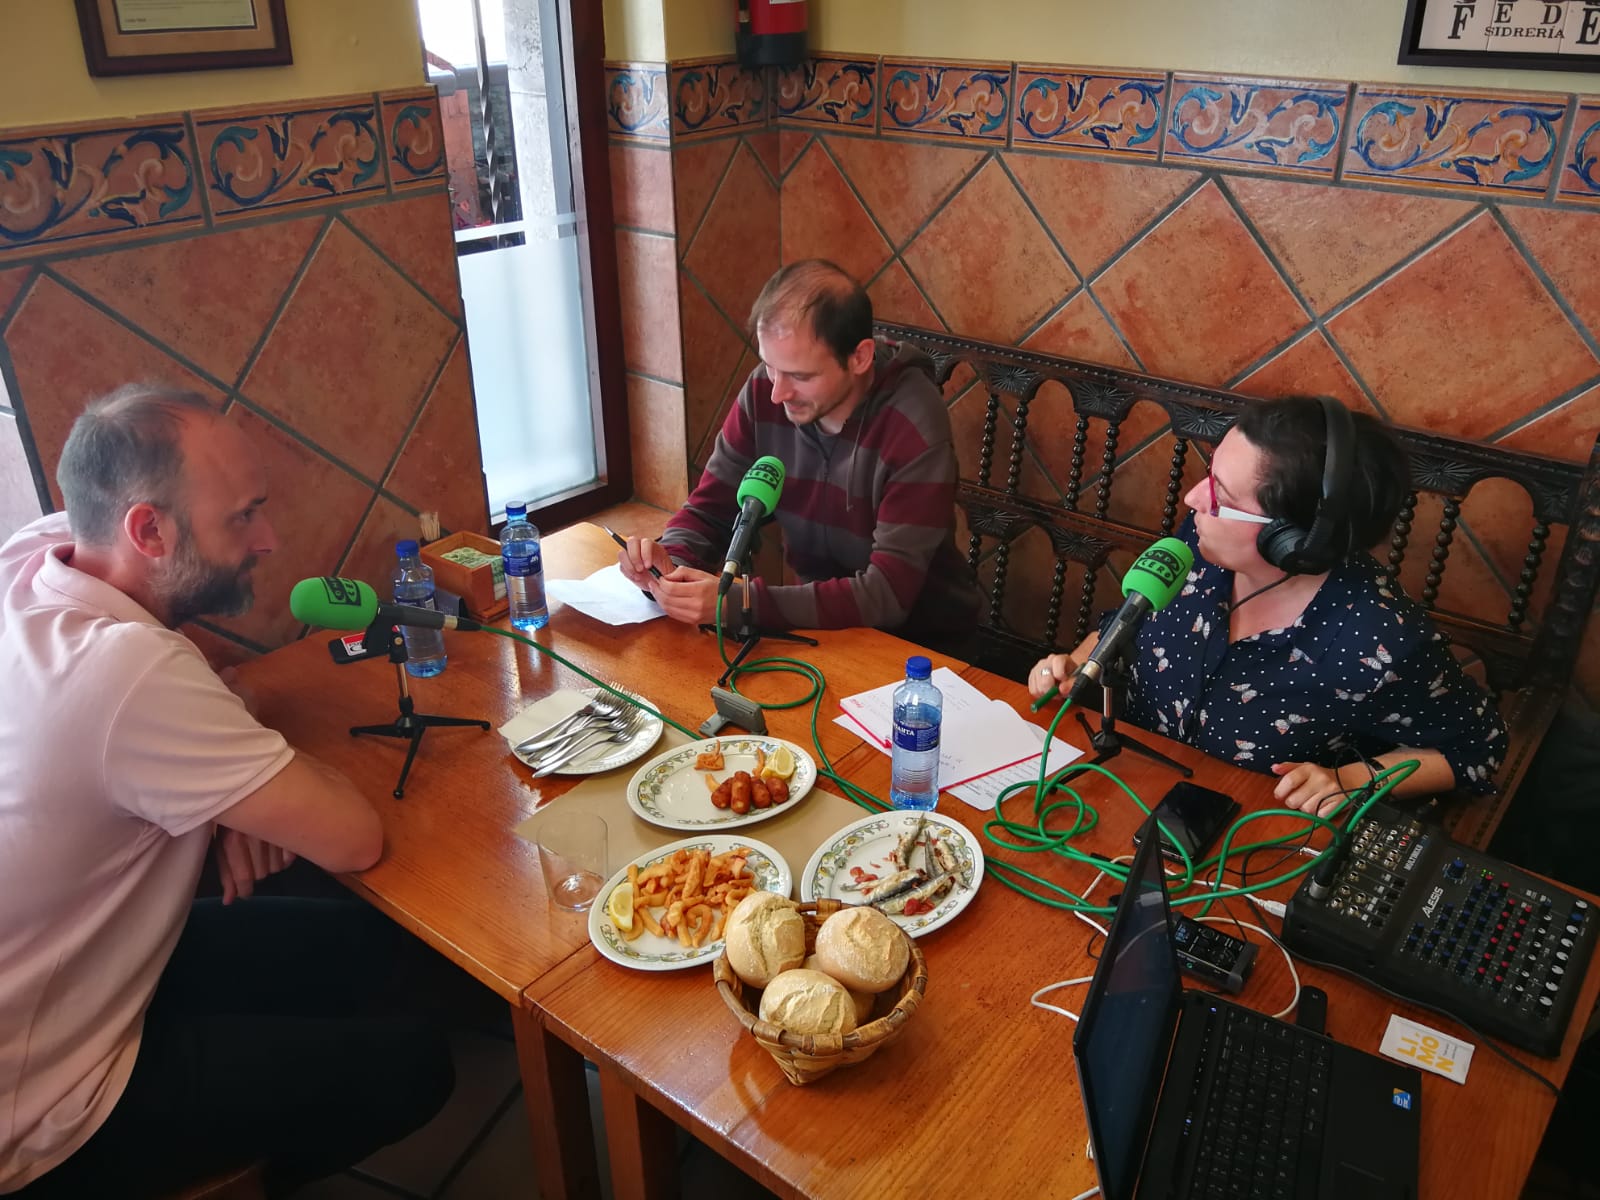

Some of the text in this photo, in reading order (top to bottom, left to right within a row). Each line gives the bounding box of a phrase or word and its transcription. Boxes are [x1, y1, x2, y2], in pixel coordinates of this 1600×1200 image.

[1484, 25, 1565, 39] SIDRERÍA
[1141, 560, 1172, 579] CERO
[1145, 550, 1178, 572] ONDA
[1422, 886, 1444, 918] ALESIS
